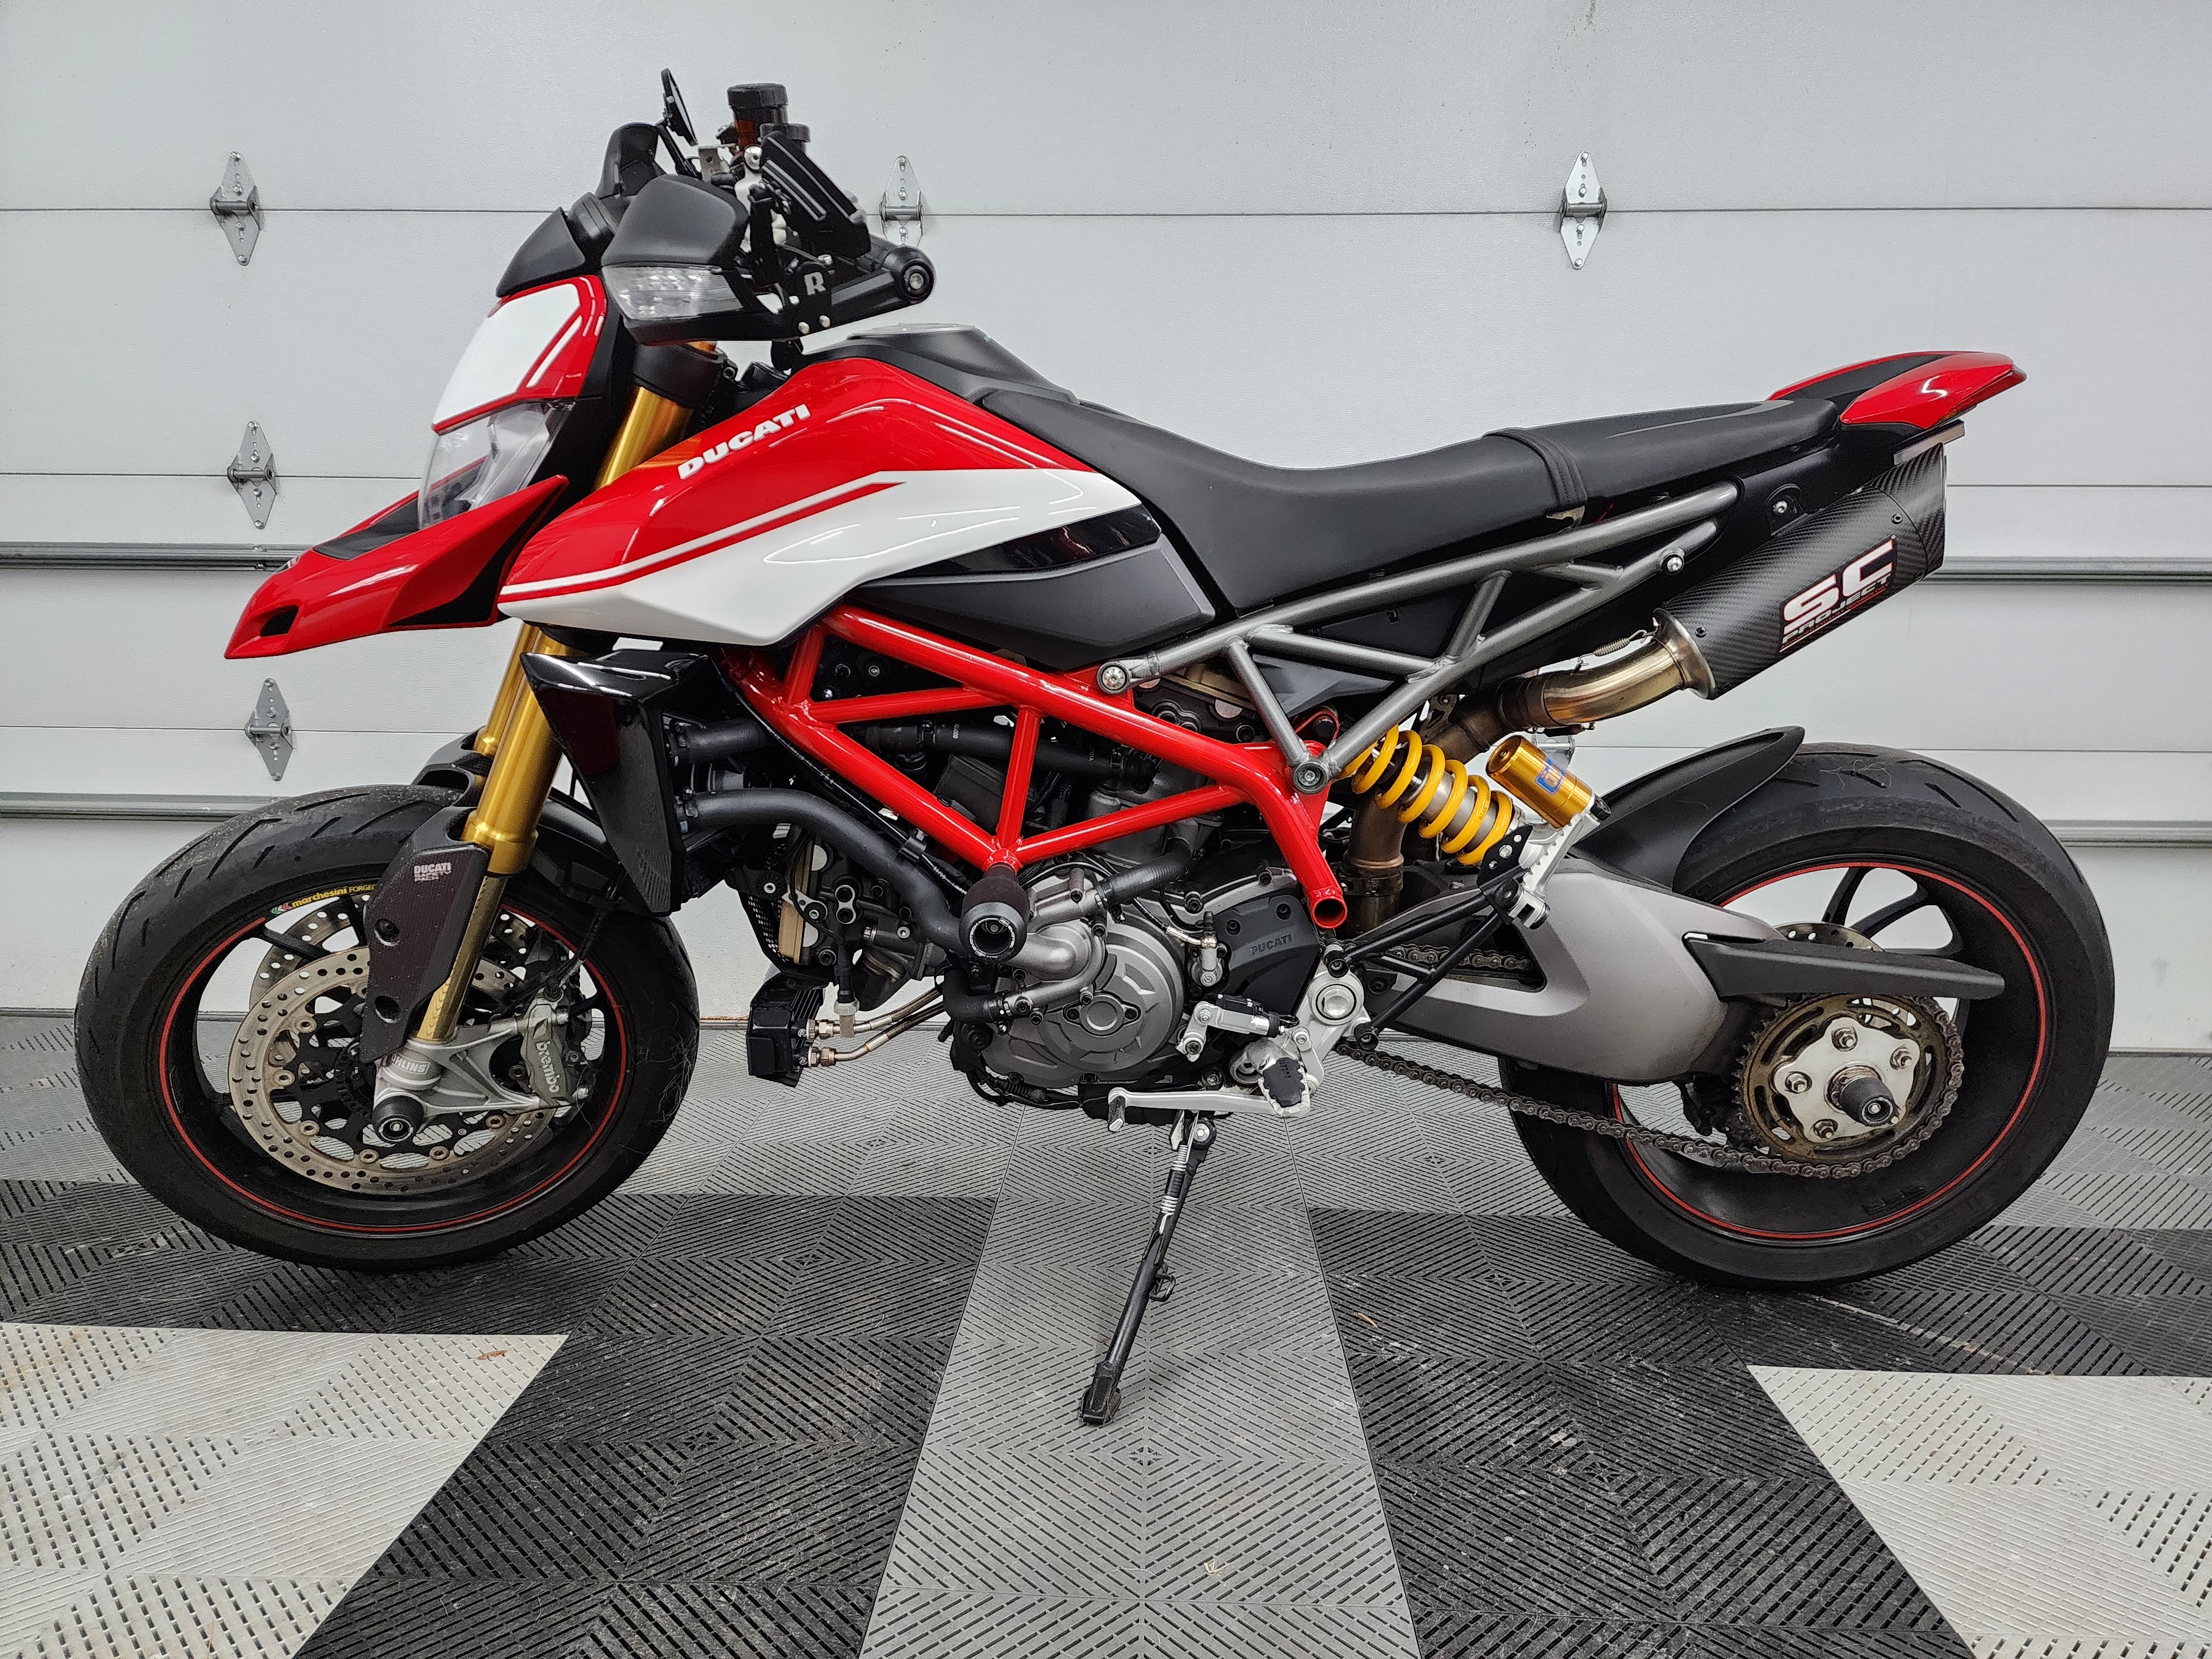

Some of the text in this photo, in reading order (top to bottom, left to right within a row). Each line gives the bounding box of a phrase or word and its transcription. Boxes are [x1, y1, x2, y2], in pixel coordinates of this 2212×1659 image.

[804, 272, 826, 296] R
[677, 404, 811, 479] DUCATI
[1782, 573, 1891, 644] PROJECT
[1783, 539, 1893, 635] SC
[1780, 582, 1889, 649] ADVANCED EXHAUST TECHNOLOGY
[414, 862, 452, 874] DUCATI
[291, 888, 347, 908] marchesini
[1249, 933, 1293, 956] DUCATI
[536, 1040, 560, 1093] brembo
